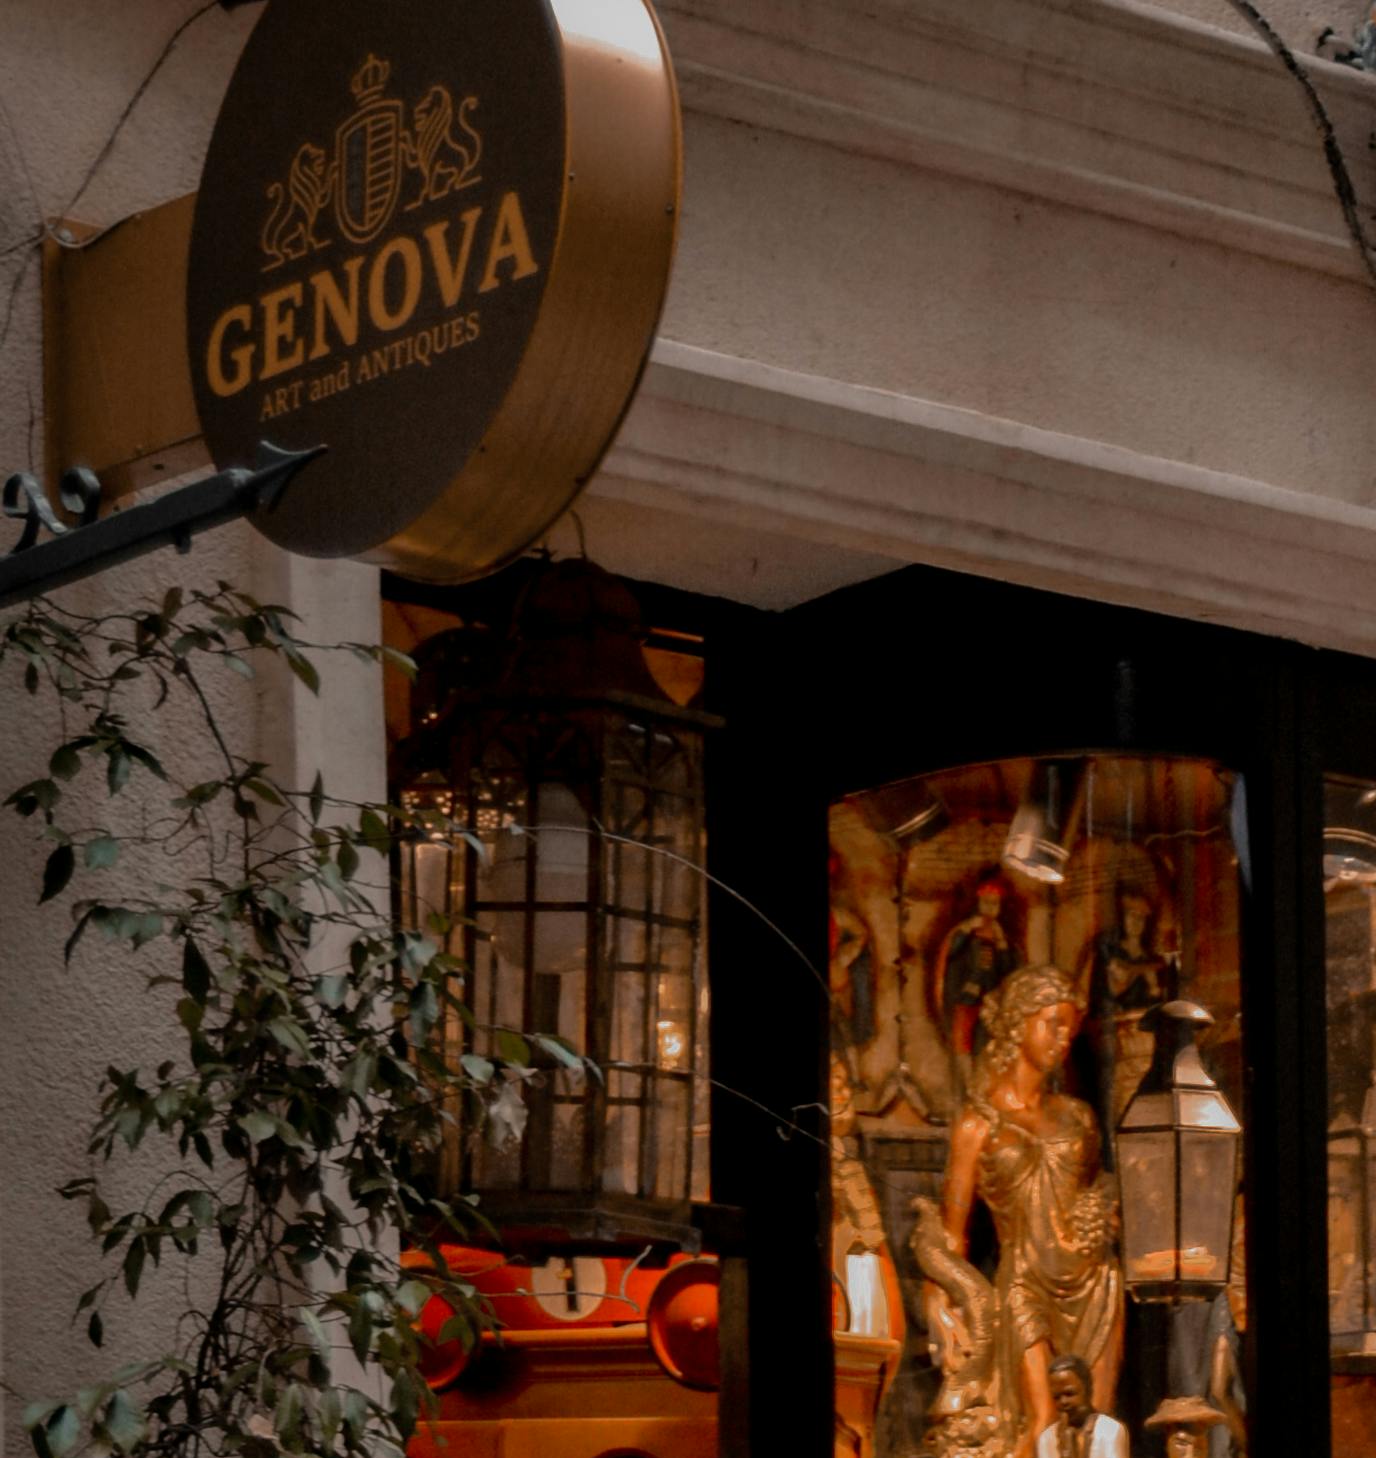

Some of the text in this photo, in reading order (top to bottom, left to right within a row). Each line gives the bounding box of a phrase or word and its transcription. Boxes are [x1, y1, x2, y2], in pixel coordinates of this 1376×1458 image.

[206, 191, 538, 397] GENOVA
[259, 311, 481, 421] ART and ANTIQUES
